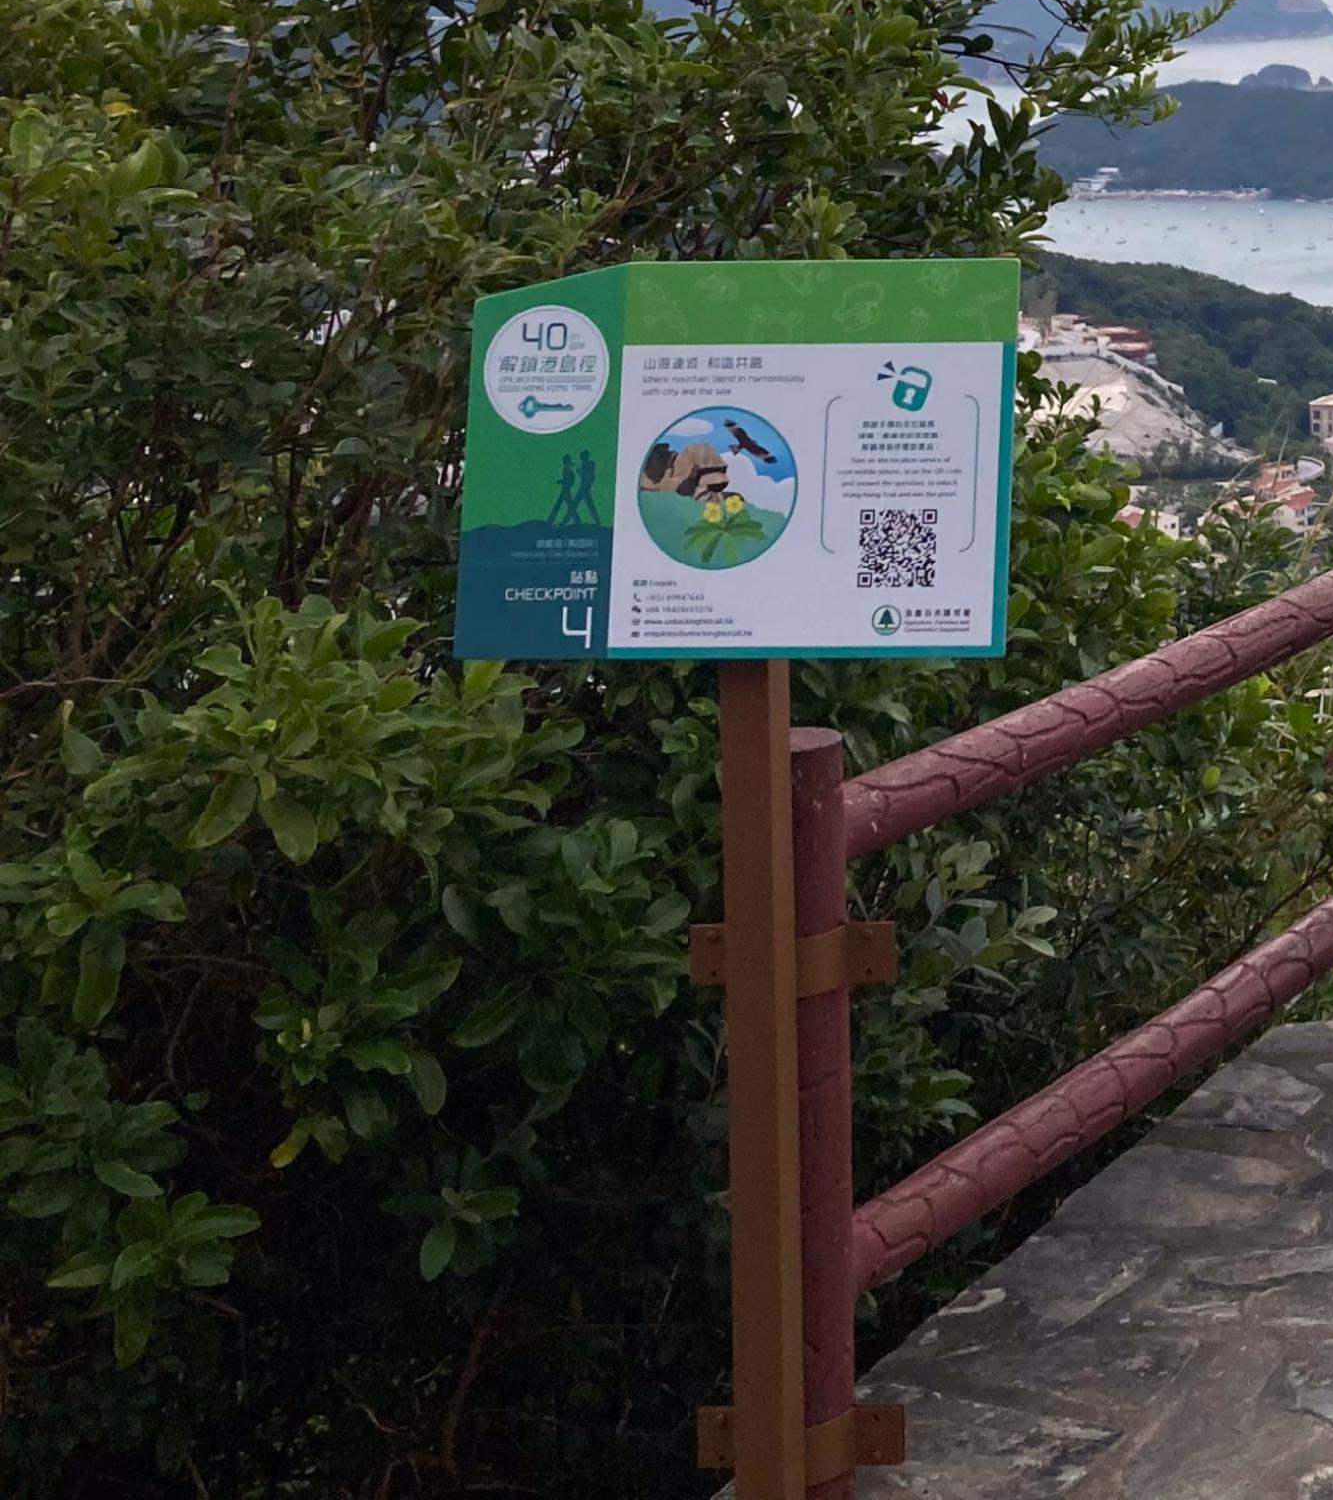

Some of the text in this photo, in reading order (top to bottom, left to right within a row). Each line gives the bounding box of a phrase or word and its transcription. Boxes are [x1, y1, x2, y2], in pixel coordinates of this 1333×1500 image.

[522, 322, 567, 351] 40
[498, 354, 598, 373] 解鎖港島徑
[681, 387, 696, 396] and
[699, 387, 713, 396] the
[570, 570, 598, 584] 站點
[505, 587, 598, 601] CHECKPOINT
[562, 606, 593, 649] 4
